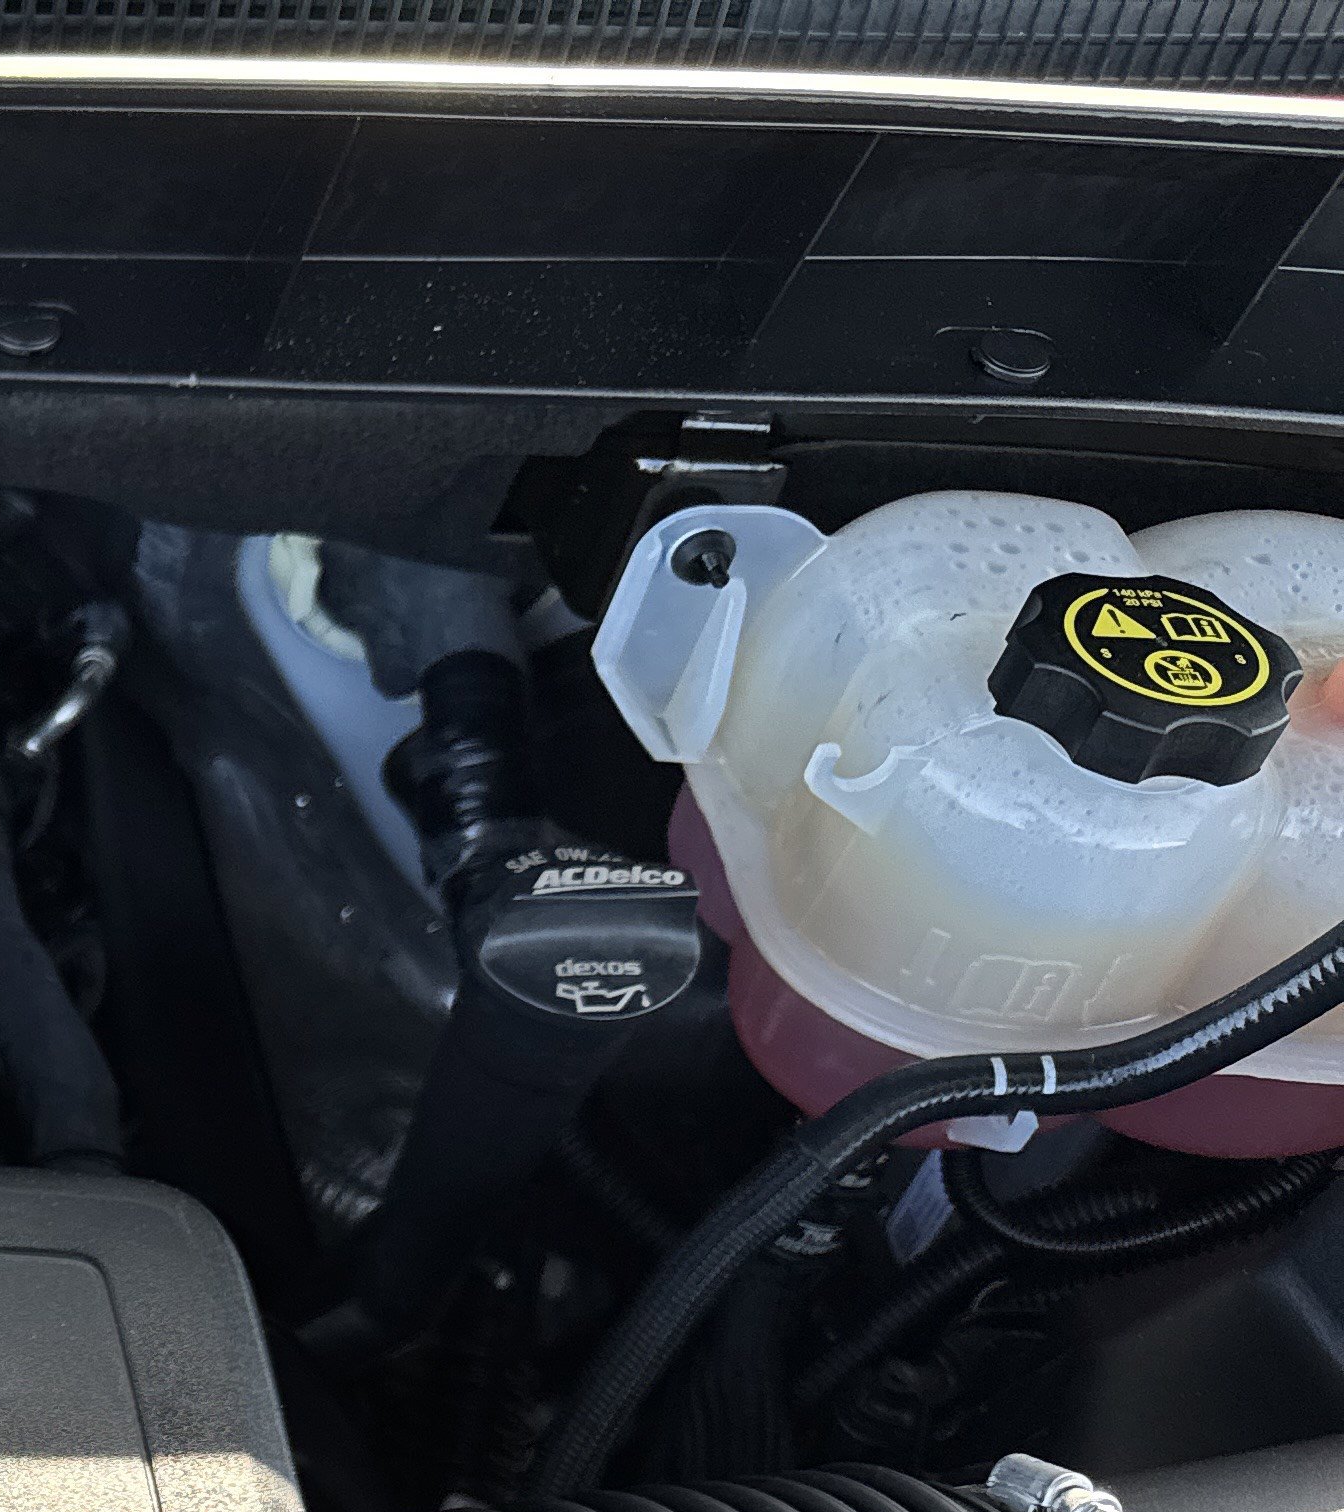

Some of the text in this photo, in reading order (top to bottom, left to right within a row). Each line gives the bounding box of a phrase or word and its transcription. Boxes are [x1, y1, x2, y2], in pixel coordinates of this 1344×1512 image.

[1123, 598, 1164, 608] 20 PSI
[1136, 589, 1163, 599] kPa
[505, 848, 548, 873] SAE
[531, 865, 686, 891] ACDelco
[555, 957, 643, 977] dexos
